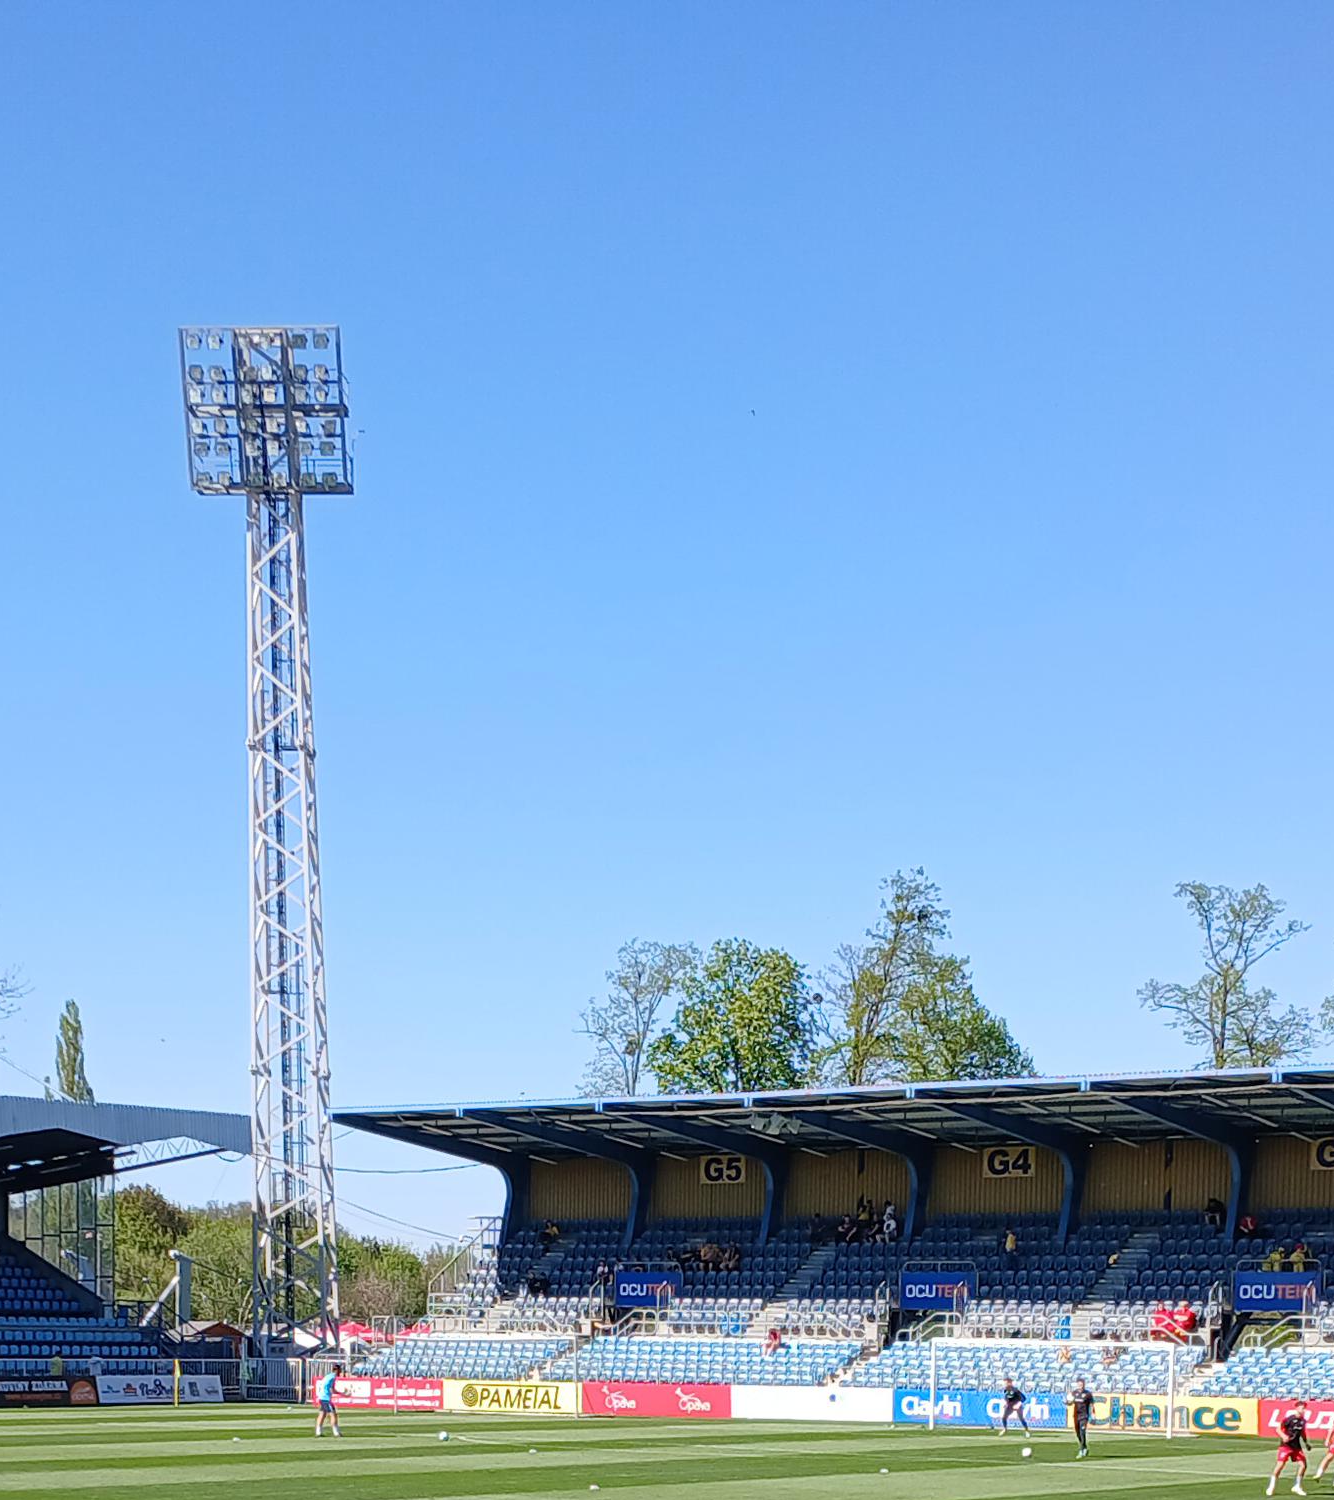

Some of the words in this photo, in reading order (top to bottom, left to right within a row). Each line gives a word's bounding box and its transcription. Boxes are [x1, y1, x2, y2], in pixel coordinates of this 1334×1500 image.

[704, 1157, 742, 1182] G5
[987, 1148, 1032, 1175] G4
[479, 1386, 562, 1410] PAMETAL
[604, 1394, 637, 1411] Opava
[678, 1395, 711, 1413] Opava
[1088, 1395, 1242, 1431] Chance
